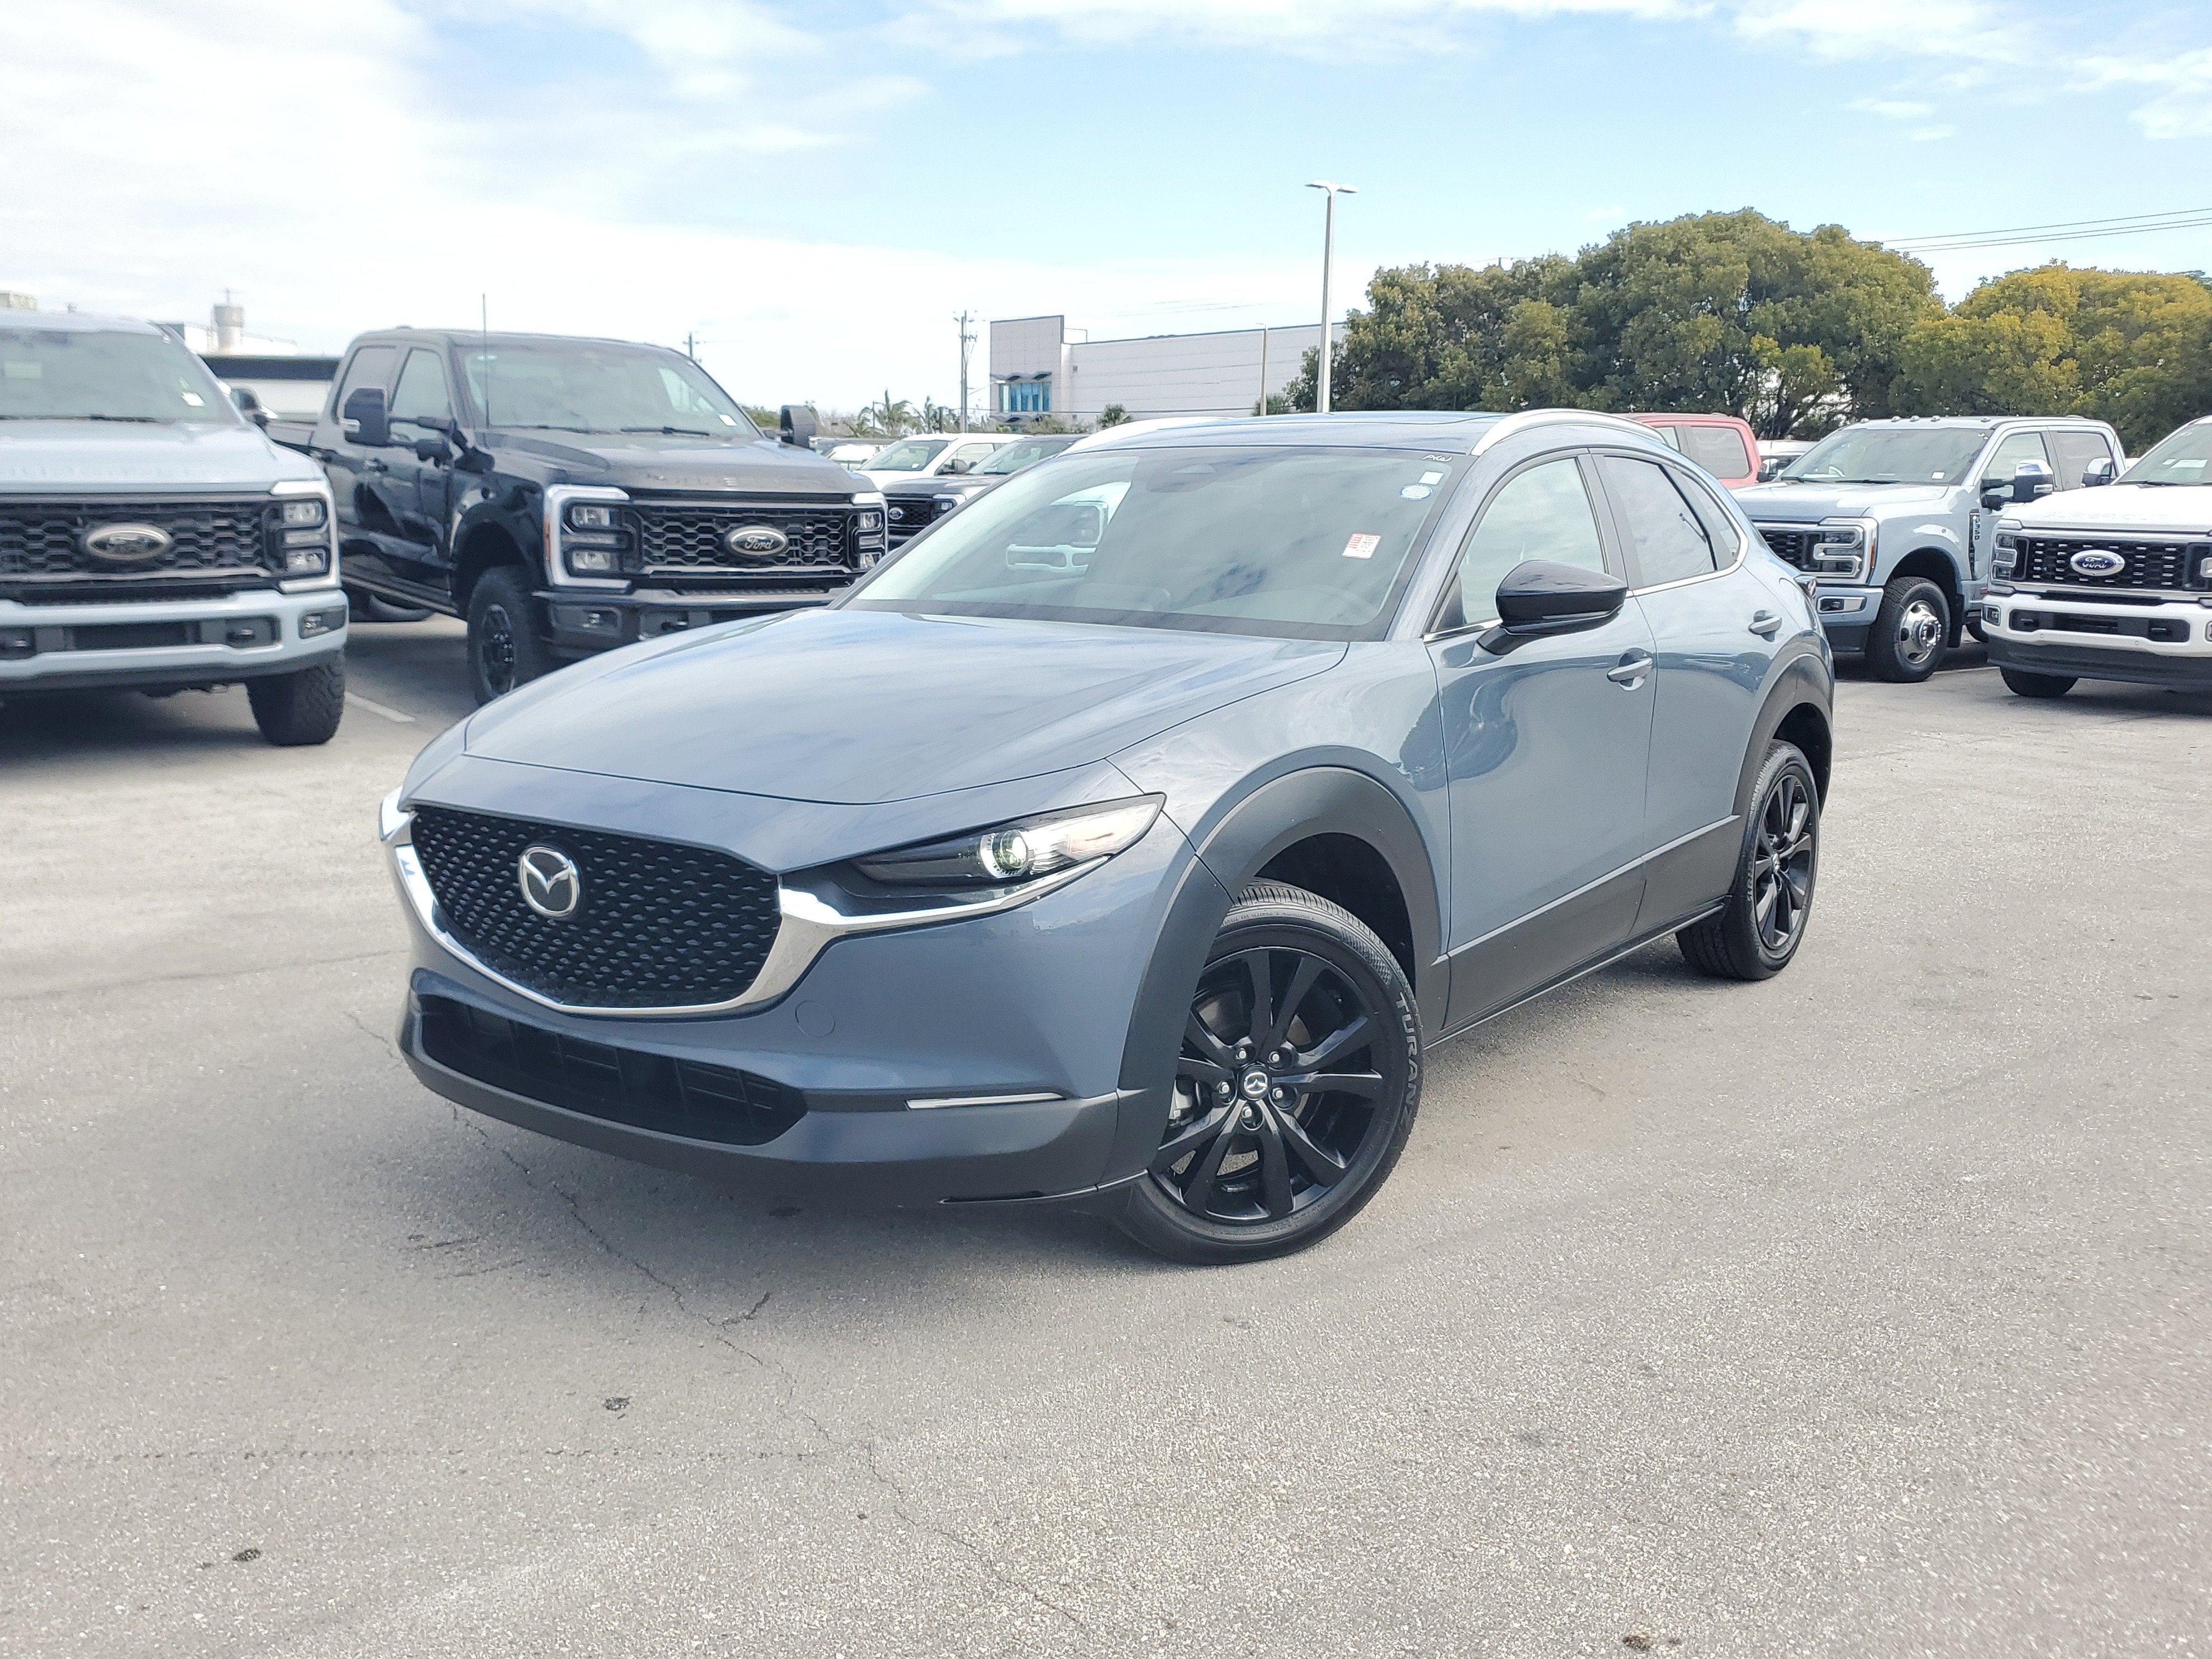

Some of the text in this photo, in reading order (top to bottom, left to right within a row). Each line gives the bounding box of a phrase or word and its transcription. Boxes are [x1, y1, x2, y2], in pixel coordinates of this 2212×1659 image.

[744, 535, 774, 550] Ford
[2083, 557, 2108, 568] Ford
[1393, 991, 1418, 1136] TURANZ
